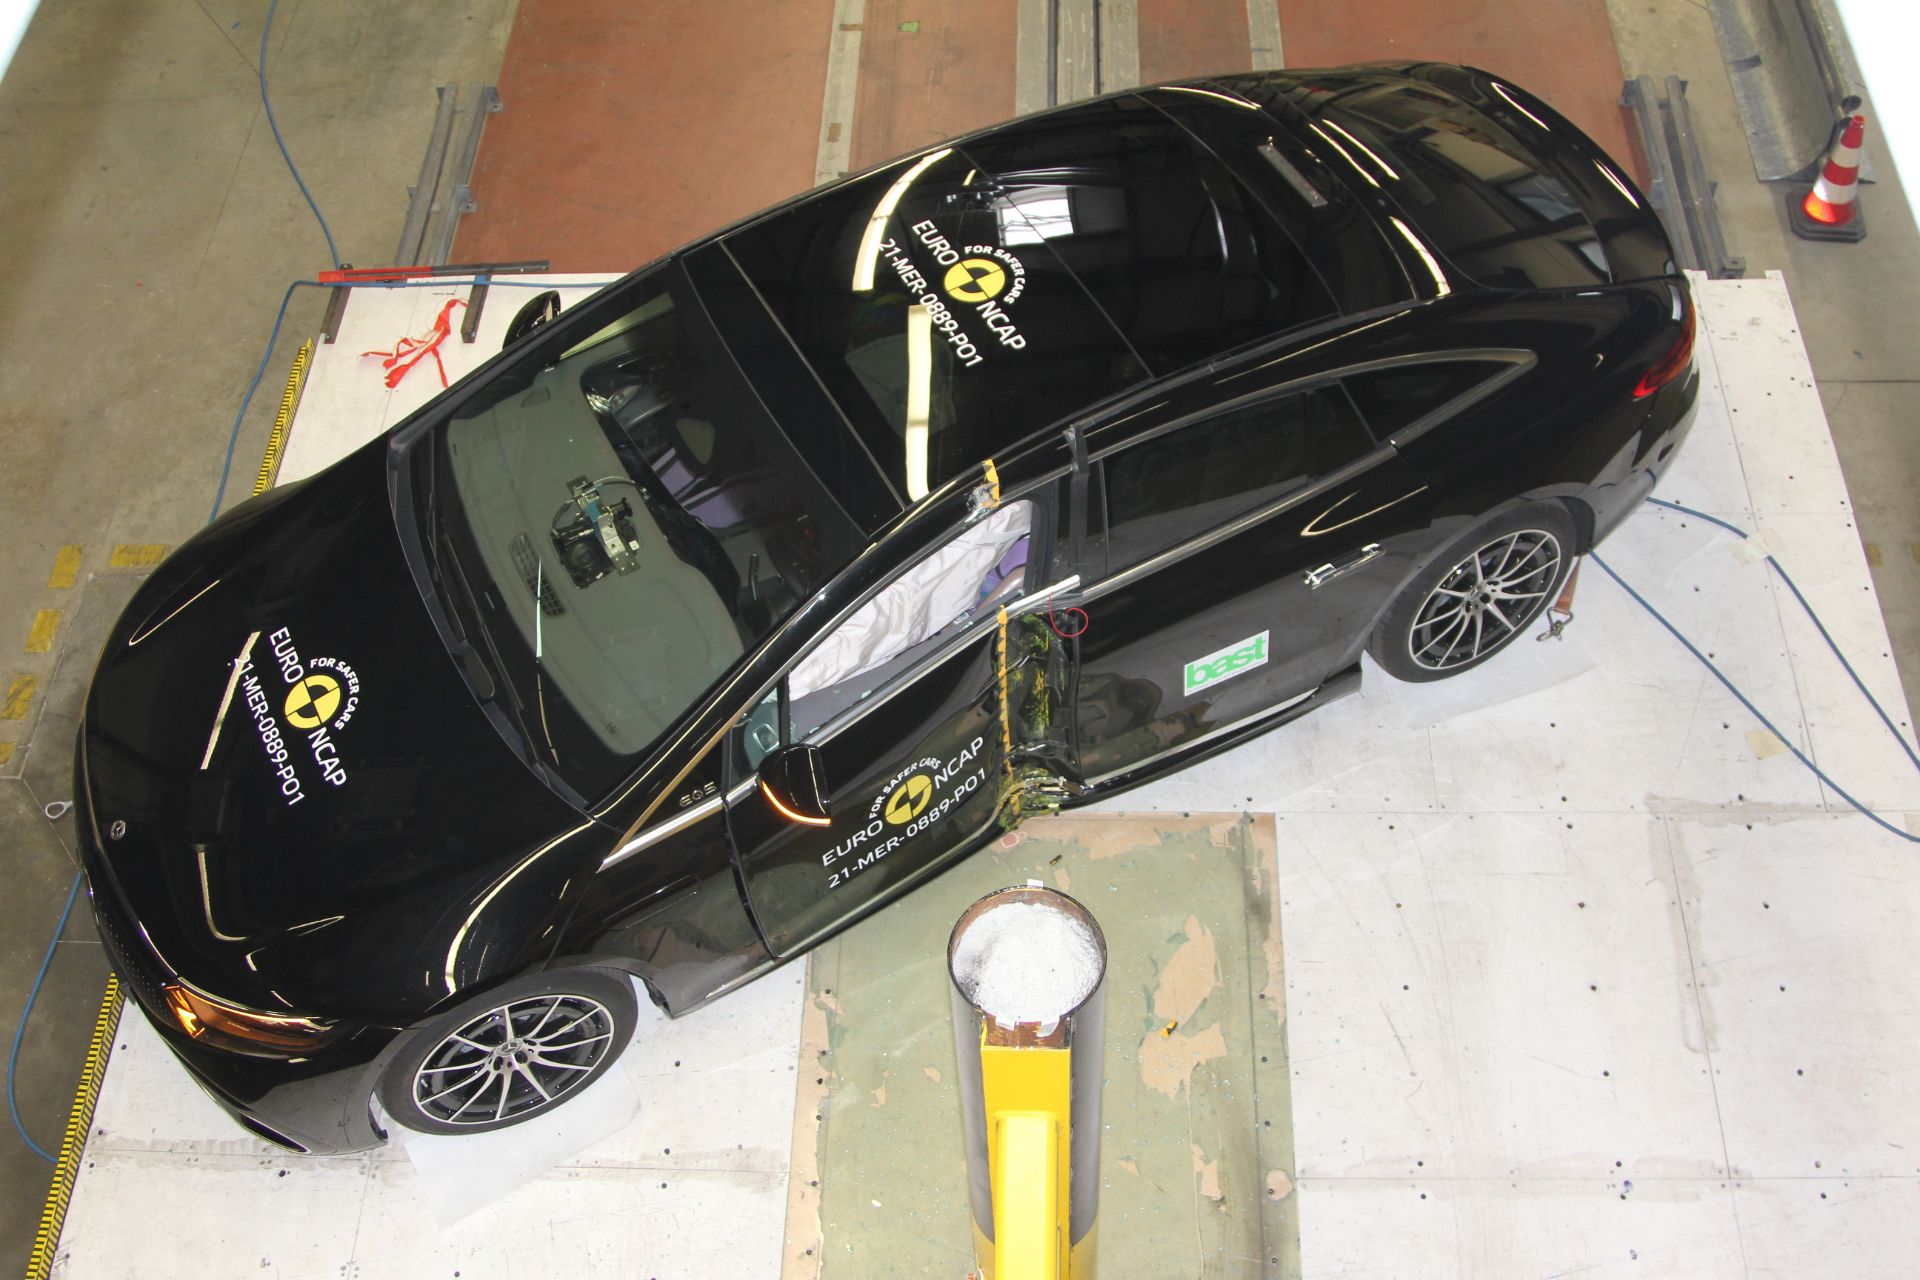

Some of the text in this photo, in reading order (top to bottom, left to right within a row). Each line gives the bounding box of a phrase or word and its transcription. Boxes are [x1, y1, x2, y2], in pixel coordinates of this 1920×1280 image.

[912, 219, 1026, 350] EURO NCAP
[963, 244, 1026, 304] FOR SAFER CARS
[310, 657, 360, 731] FOR SAFER CARS
[1186, 636, 1265, 688] bast
[269, 626, 347, 786] EURO NCAP
[821, 736, 984, 867] EURO NCAP
[869, 757, 942, 819] FOR SAFER CARS
